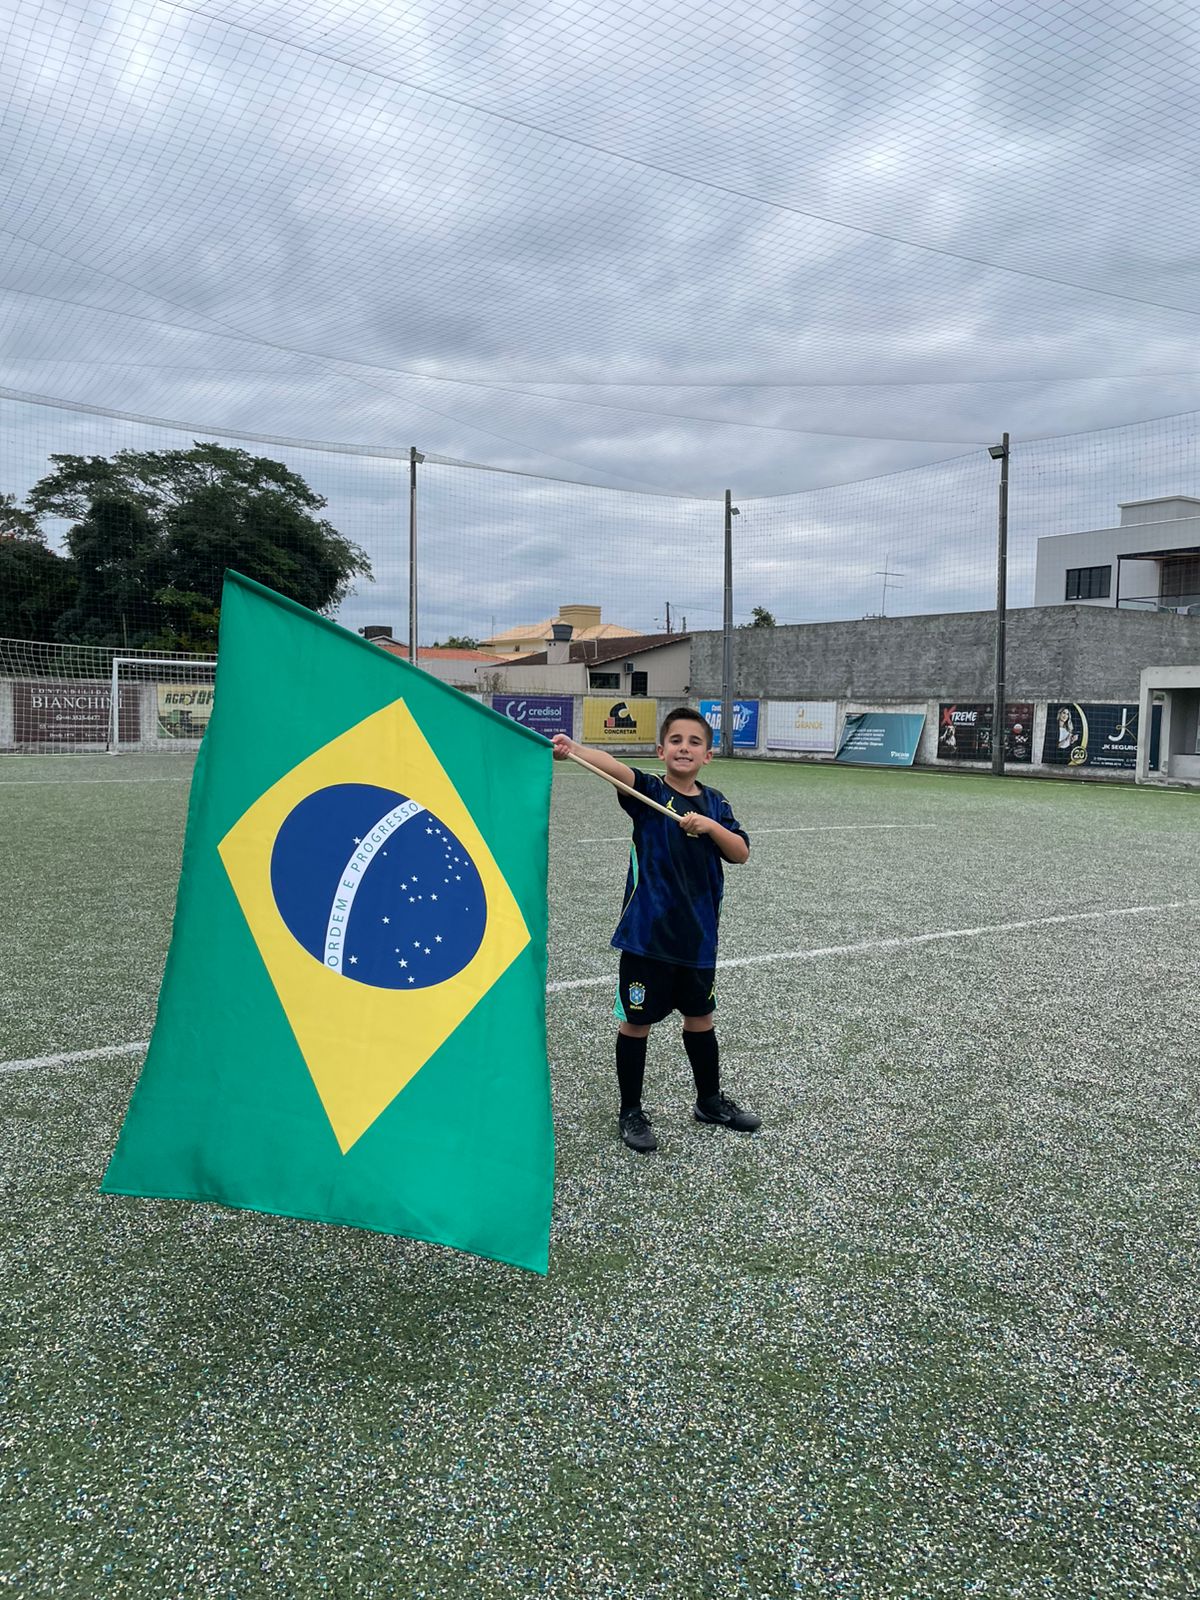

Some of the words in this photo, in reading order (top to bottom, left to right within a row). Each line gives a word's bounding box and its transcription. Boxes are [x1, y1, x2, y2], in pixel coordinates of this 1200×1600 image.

[528, 706, 562, 716] credisol
[941, 705, 978, 726] XTREME
[1073, 749, 1085, 759] 20
[328, 898, 348, 967] ORDEM
[343, 880, 355, 889] E
[351, 802, 419, 873] PROGRESSO
